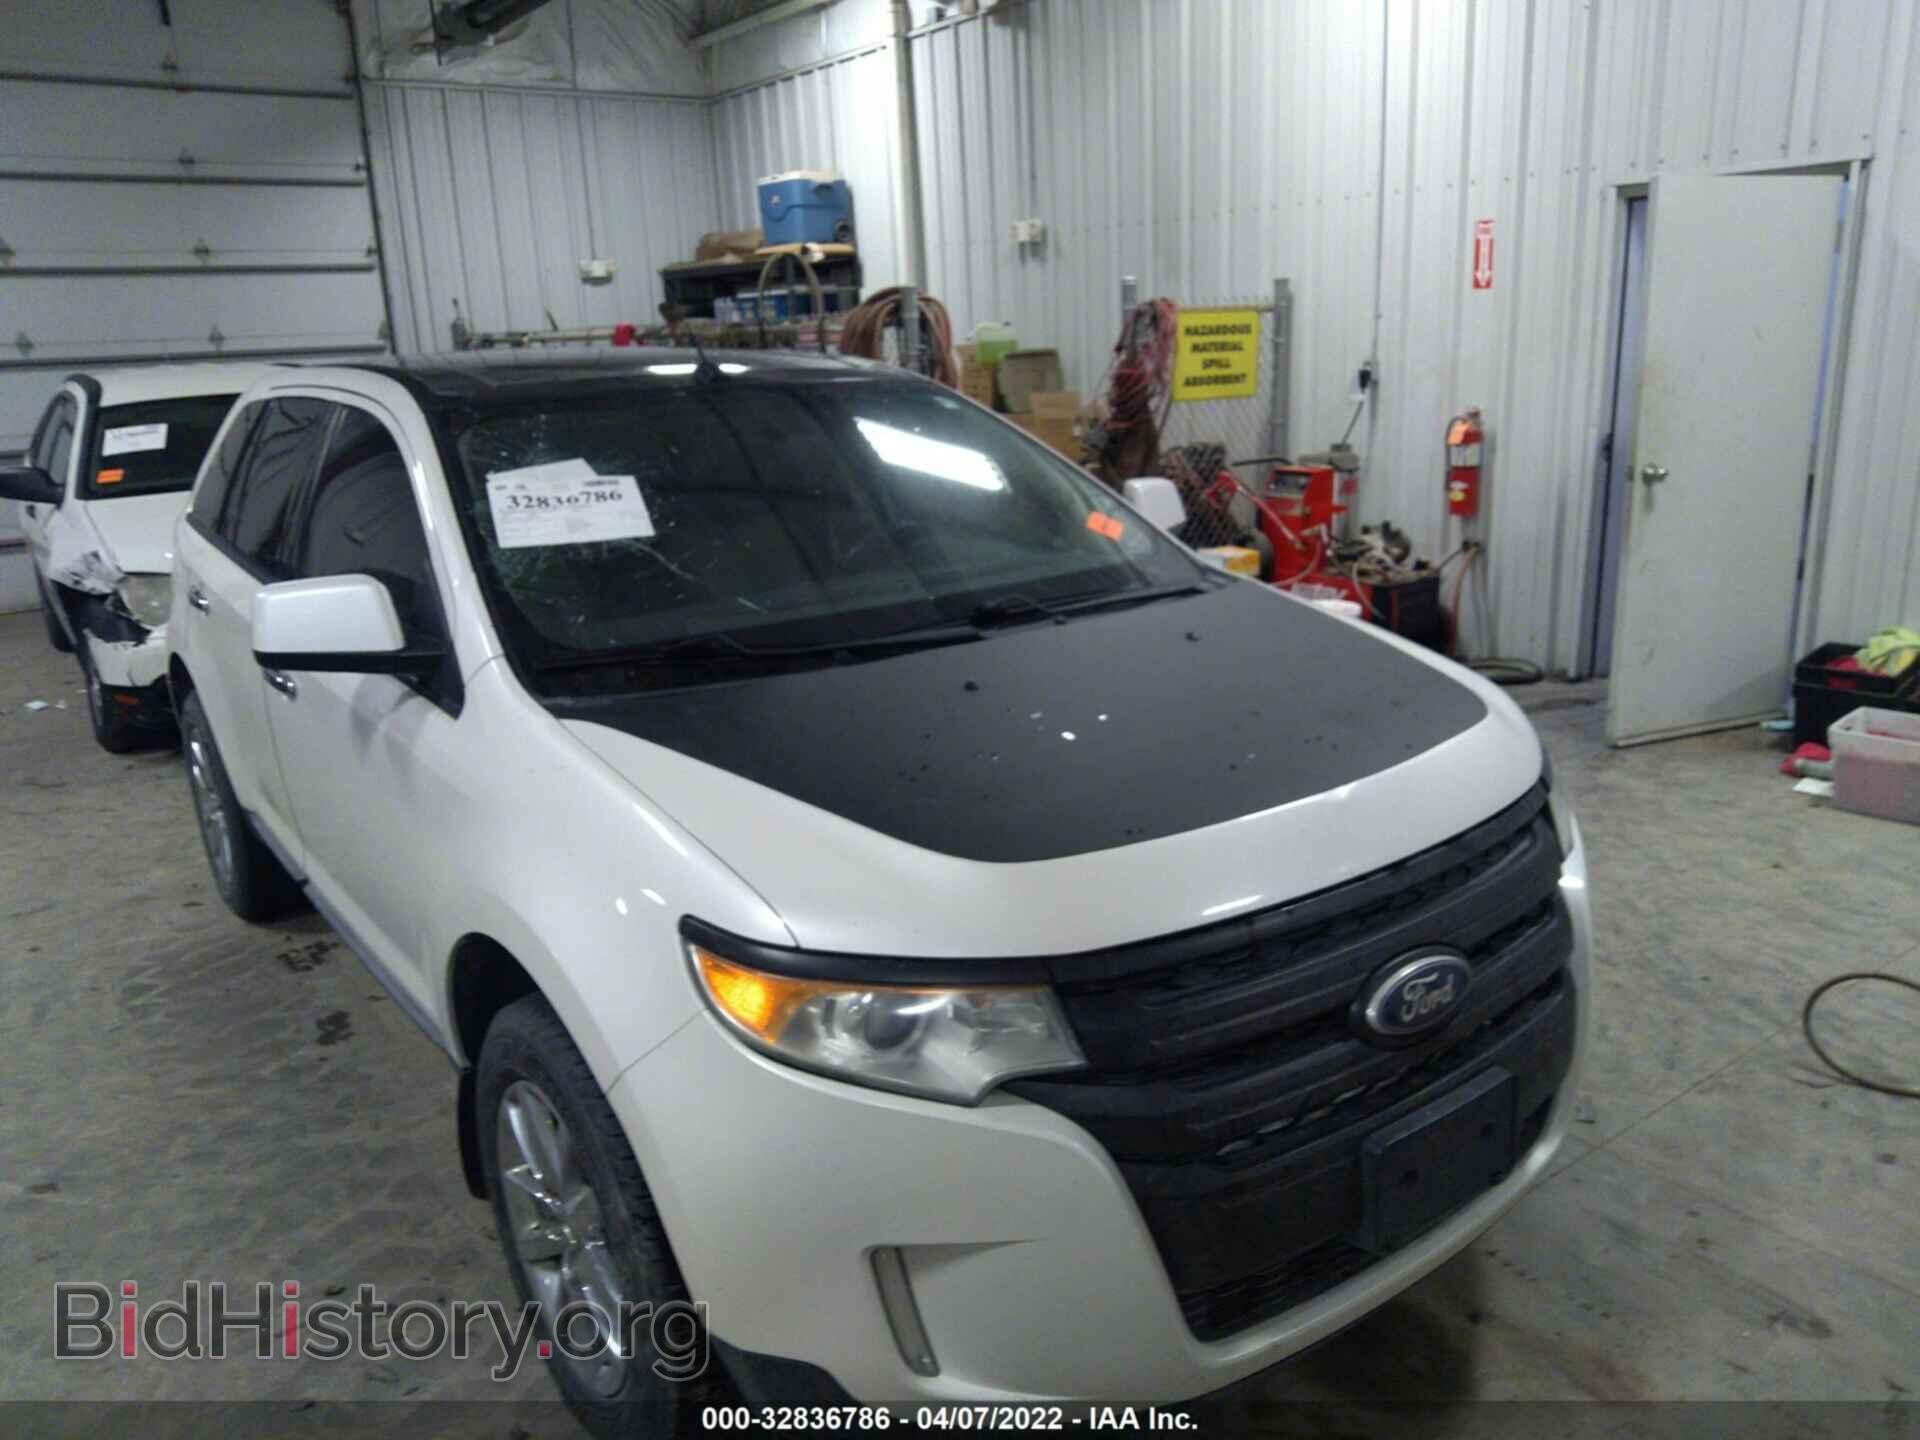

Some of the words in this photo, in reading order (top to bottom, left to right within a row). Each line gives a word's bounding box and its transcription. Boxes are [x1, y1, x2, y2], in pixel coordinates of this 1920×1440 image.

[1184, 323, 1251, 336] HAZARDOUS
[1191, 341, 1244, 352] MATERIAL
[1202, 358, 1231, 369] SPILL
[507, 489, 622, 509] 32836786
[1401, 972, 1455, 1021] Ford
